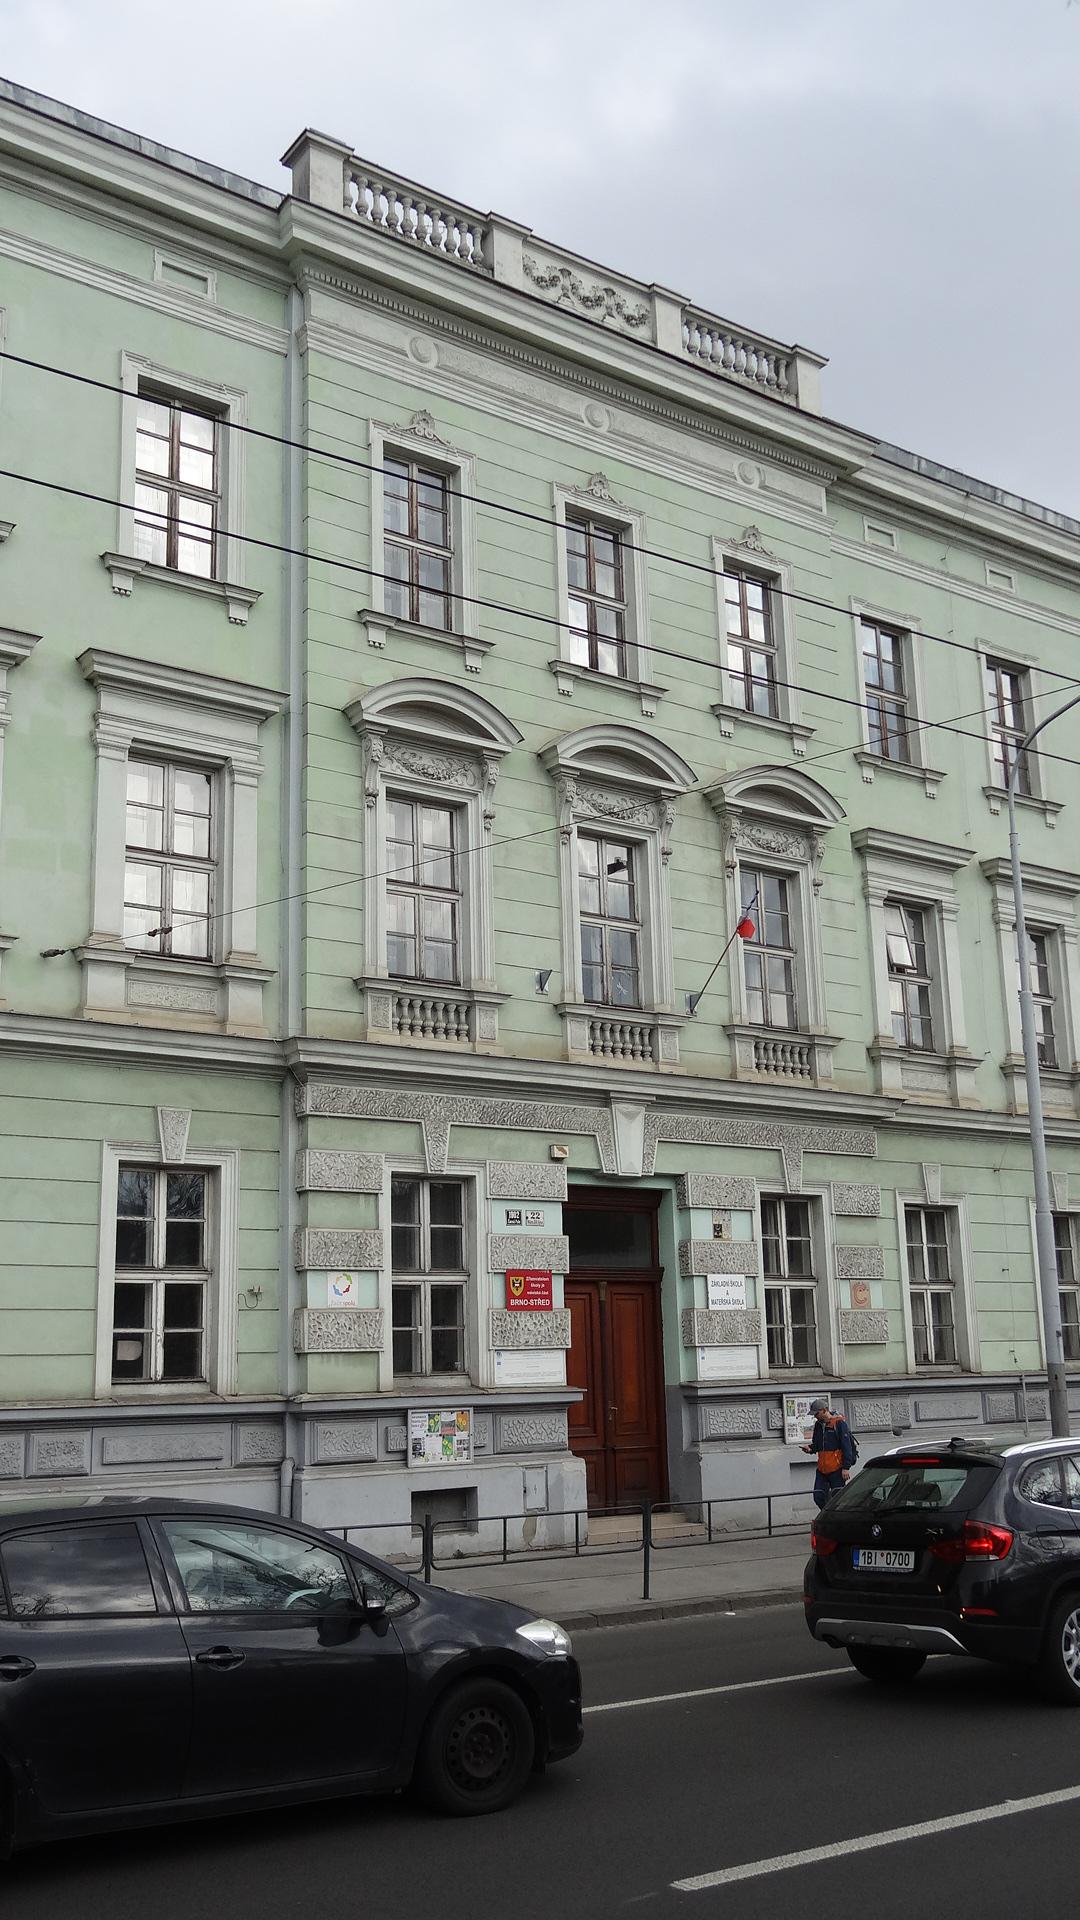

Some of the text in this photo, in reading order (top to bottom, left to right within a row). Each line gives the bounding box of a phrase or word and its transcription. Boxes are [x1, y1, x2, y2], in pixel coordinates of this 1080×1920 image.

[530, 1211, 541, 1220] 22
[510, 1298, 551, 1307] BRNO-STŘED
[861, 1551, 910, 1567] 1BI 0700
